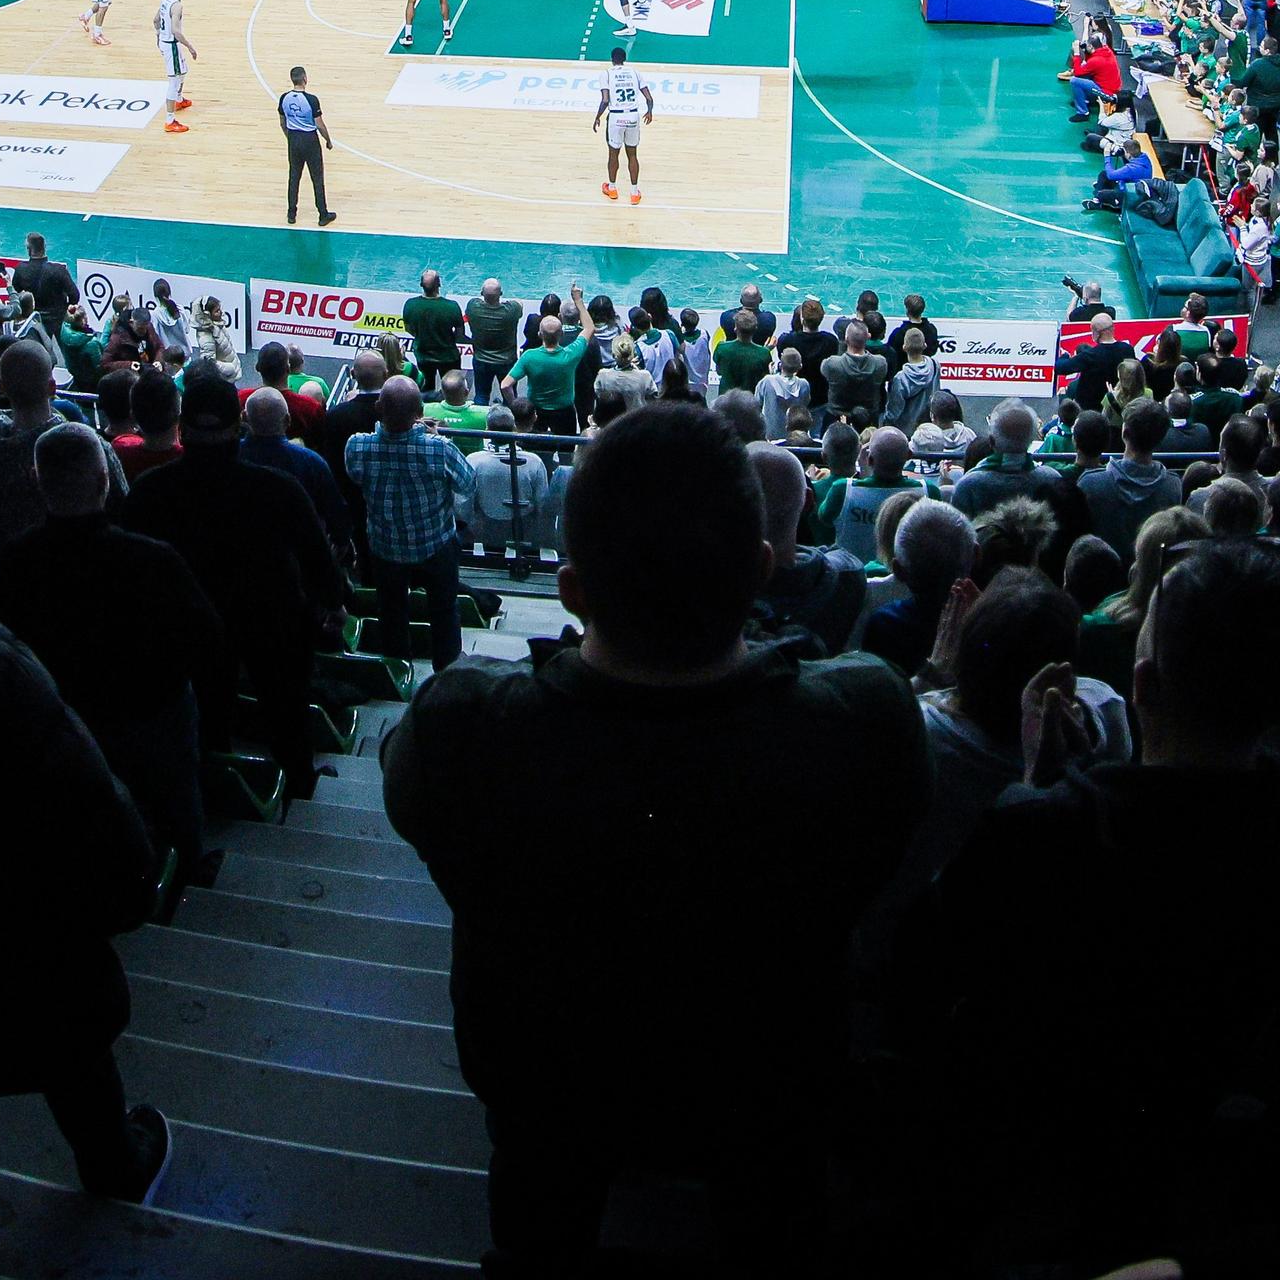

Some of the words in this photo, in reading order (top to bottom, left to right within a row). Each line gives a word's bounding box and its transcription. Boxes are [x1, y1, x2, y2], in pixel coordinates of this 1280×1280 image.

[39, 91, 151, 112] Pekao
[616, 89, 635, 102] 32
[261, 288, 364, 322] BRICO
[364, 315, 405, 329] MARC
[260, 322, 293, 334] CENTRUM
[294, 326, 334, 337] HANDLOWE
[935, 340, 956, 353] KS
[962, 342, 1011, 356] Zielona
[1018, 342, 1048, 356] Góra
[986, 365, 1020, 379] SWÓJ
[1023, 369, 1046, 380] CEL
